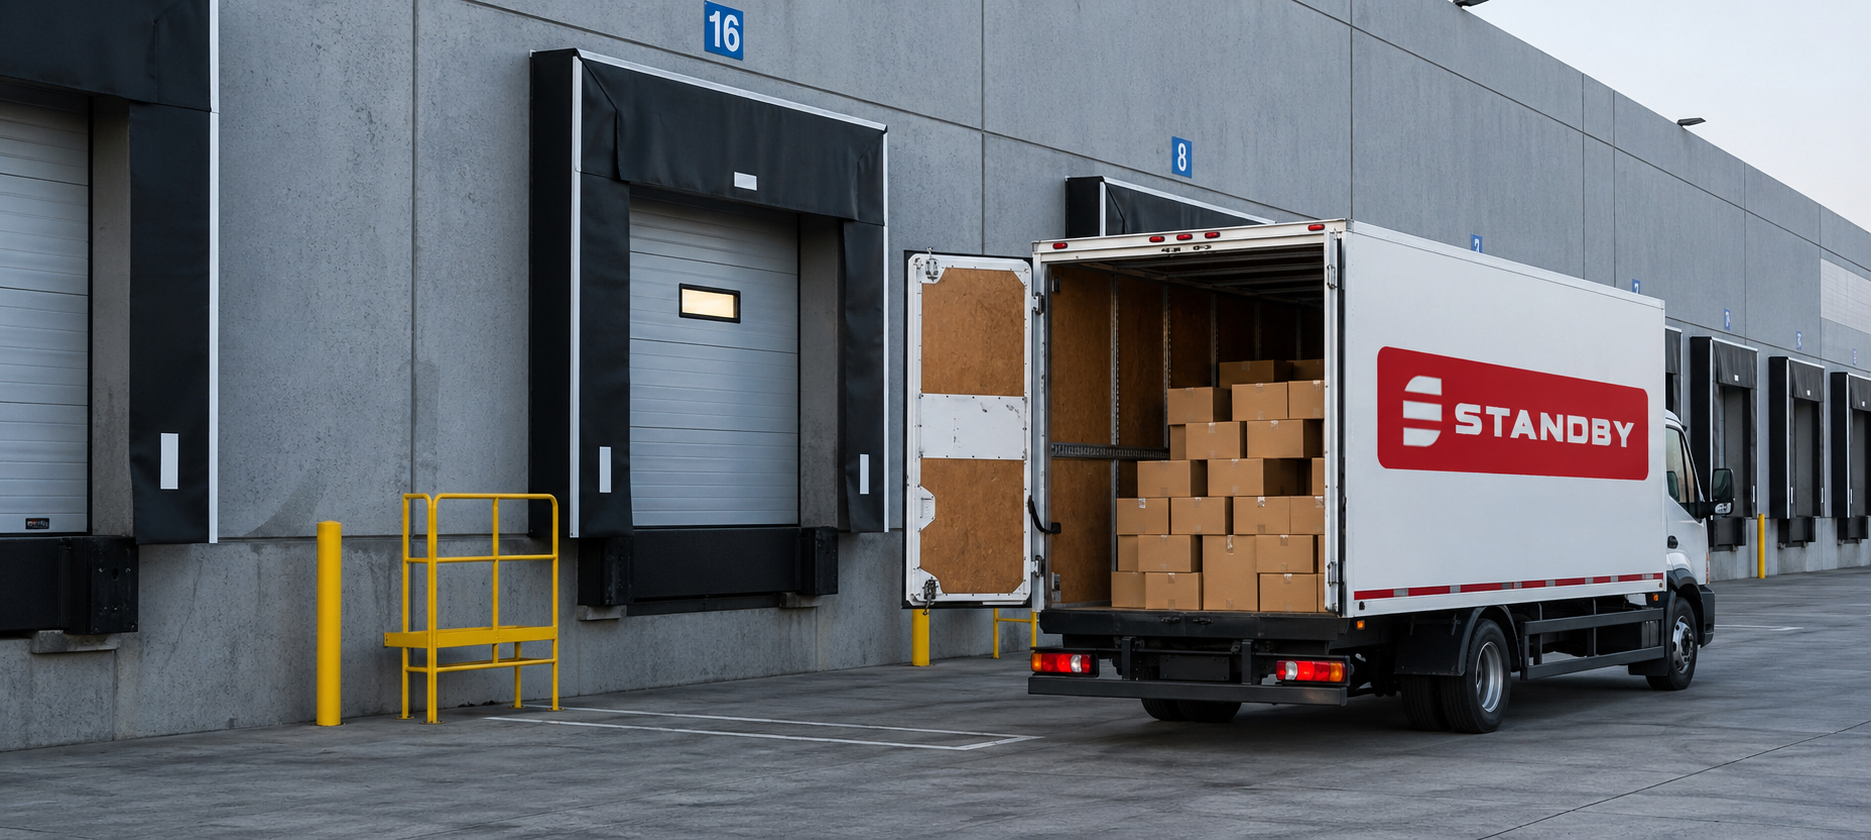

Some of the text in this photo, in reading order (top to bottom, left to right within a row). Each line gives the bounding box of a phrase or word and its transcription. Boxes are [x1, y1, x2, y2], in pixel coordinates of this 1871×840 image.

[709, 10, 740, 52] 16
[1177, 142, 1187, 172] 8
[1455, 402, 1635, 448] STANDBY
